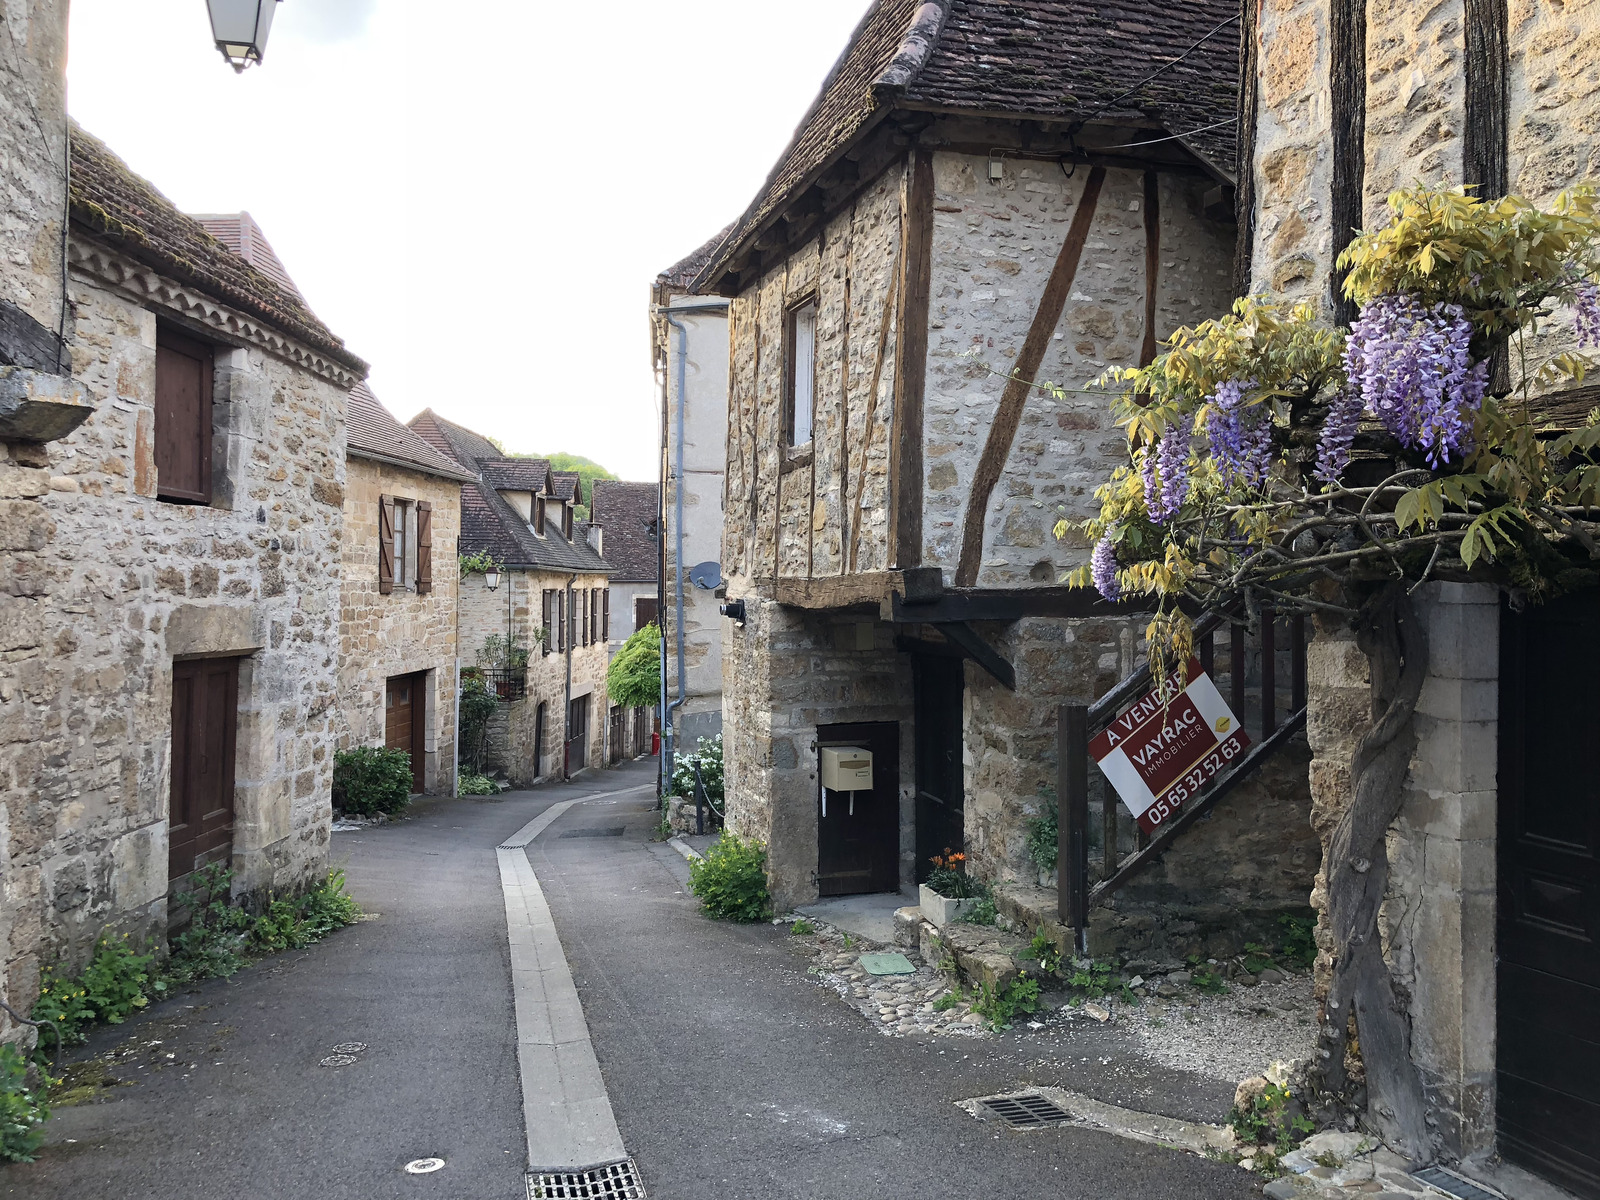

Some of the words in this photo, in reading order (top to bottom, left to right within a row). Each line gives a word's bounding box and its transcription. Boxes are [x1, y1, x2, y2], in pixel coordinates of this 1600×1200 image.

[1106, 728, 1121, 746] A
[1132, 708, 1196, 766] VAYRAC
[1144, 723, 1203, 777] IMMOBILIER
[1148, 800, 1170, 825] 05
[1167, 785, 1188, 807] 65
[1185, 769, 1206, 791] 32
[1203, 753, 1223, 776] 52
[1221, 737, 1241, 760] 63
